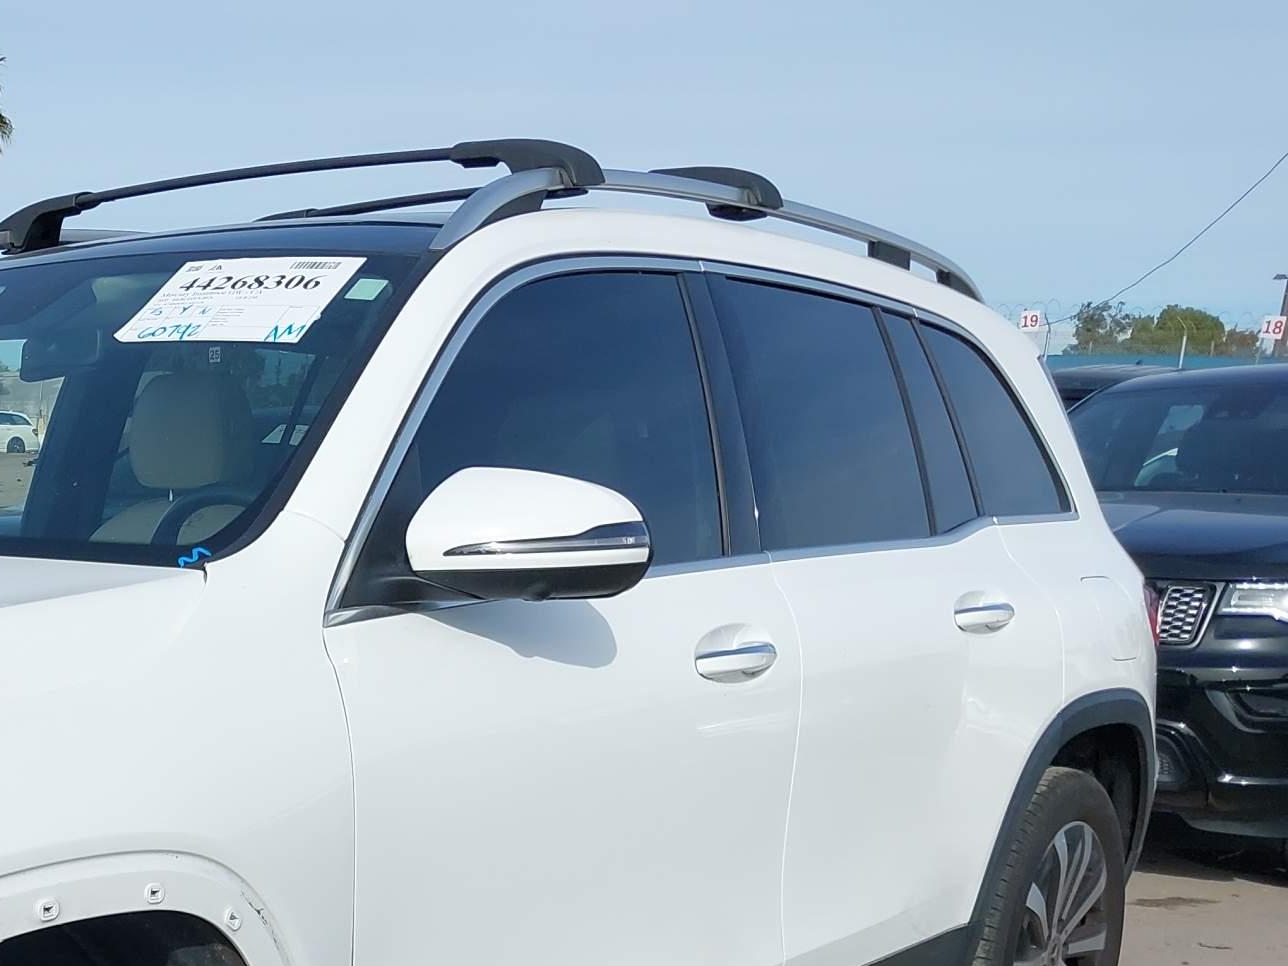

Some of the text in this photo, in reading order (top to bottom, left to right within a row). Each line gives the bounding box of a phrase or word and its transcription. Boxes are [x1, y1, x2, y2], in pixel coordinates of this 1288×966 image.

[179, 274, 328, 291] 44268306
[1021, 314, 1039, 328] 19
[1263, 320, 1284, 335] 18
